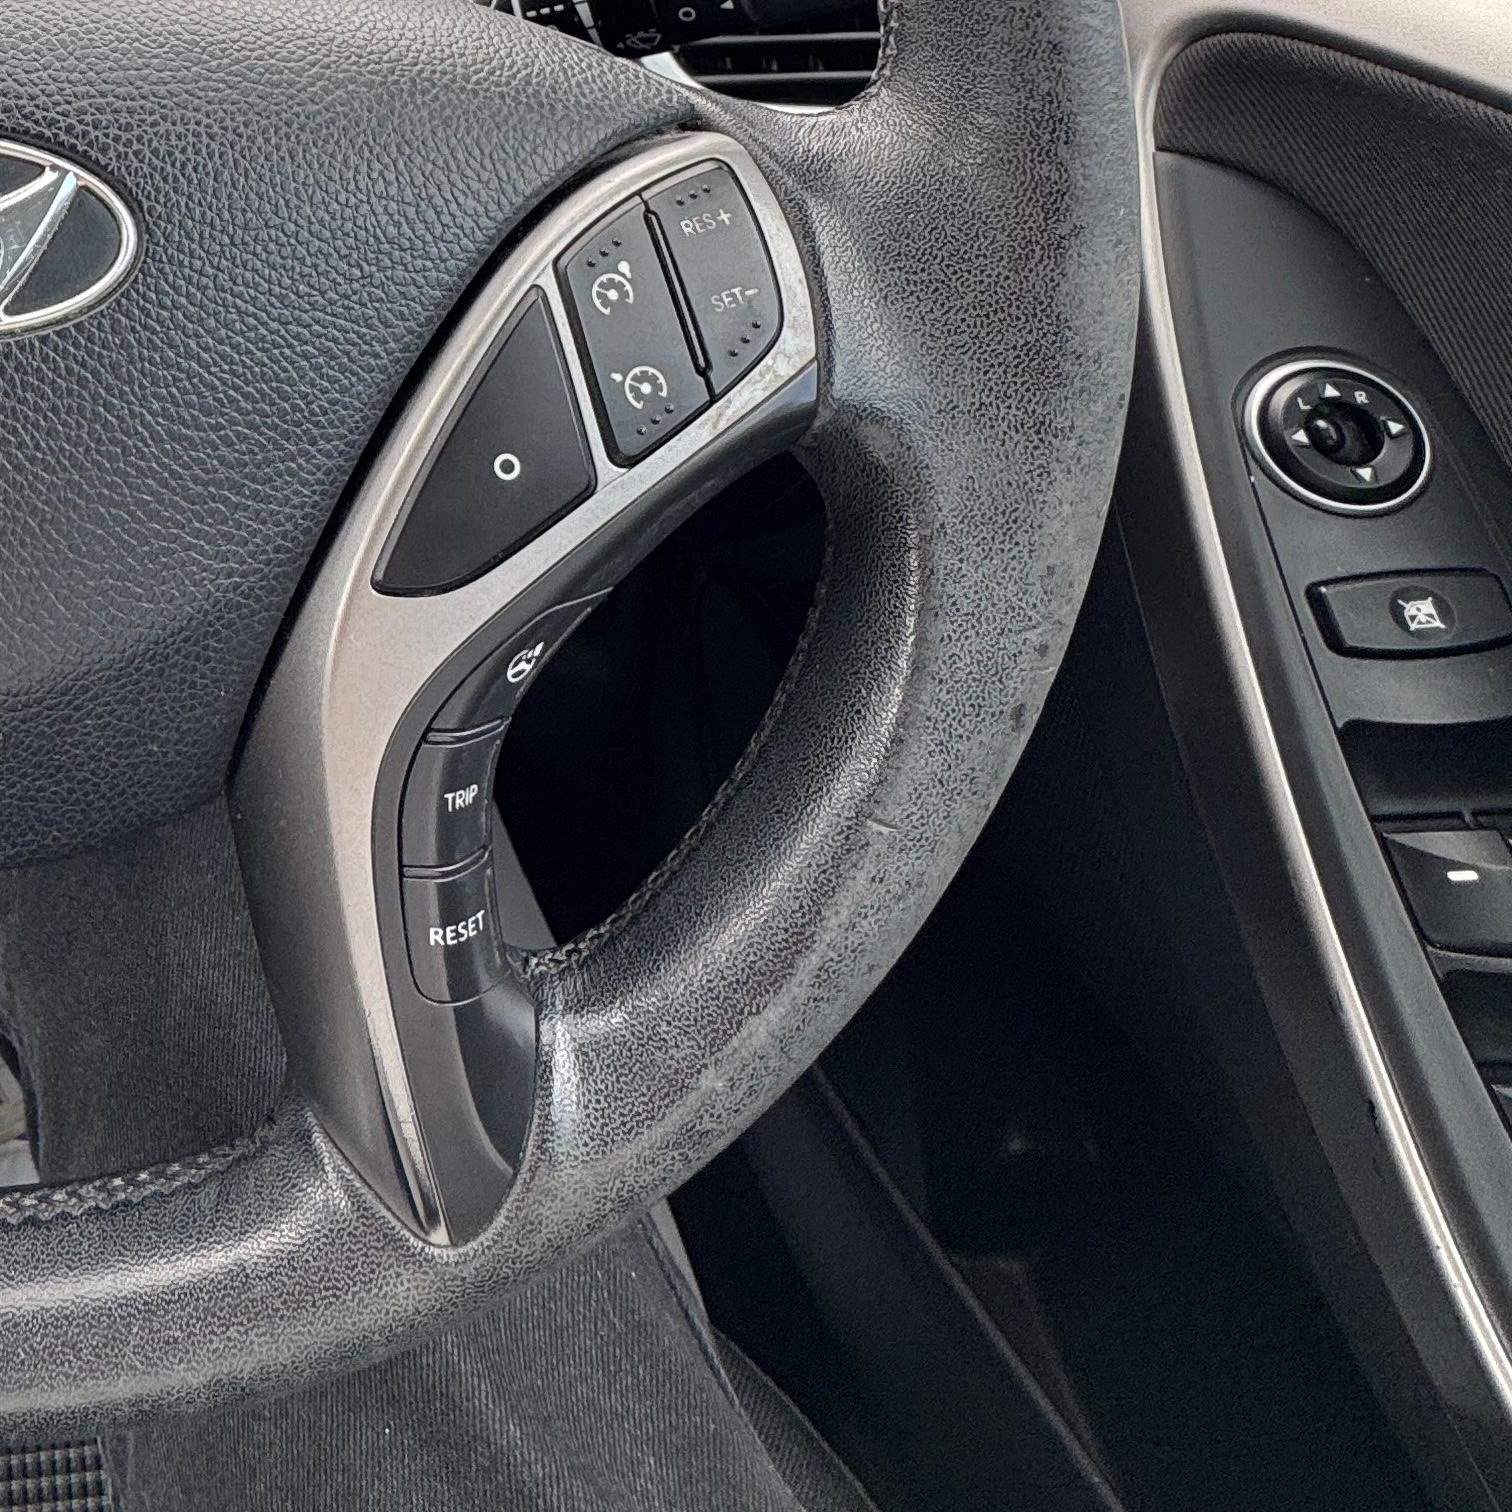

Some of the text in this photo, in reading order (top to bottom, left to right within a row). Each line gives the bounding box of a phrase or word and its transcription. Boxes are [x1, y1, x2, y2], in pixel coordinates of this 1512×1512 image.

[1296, 396, 1312, 410] L
[1354, 390, 1368, 404] R
[444, 784, 479, 813] TRIP
[429, 909, 485, 946] RESET
